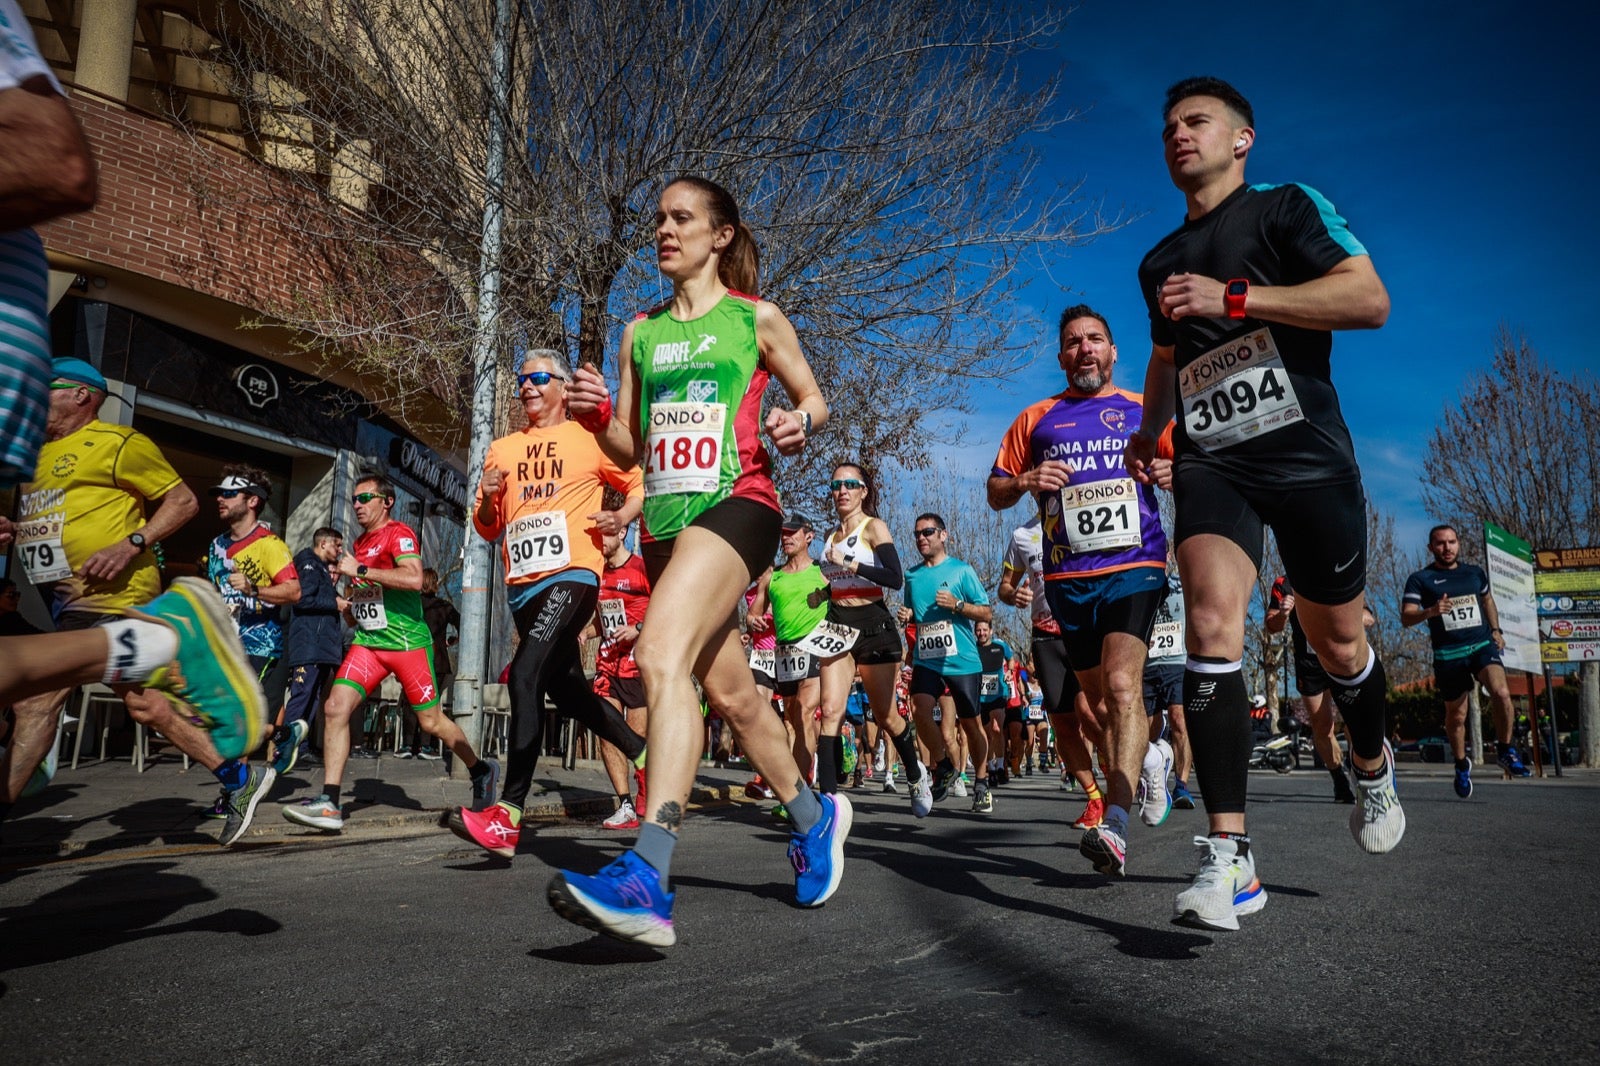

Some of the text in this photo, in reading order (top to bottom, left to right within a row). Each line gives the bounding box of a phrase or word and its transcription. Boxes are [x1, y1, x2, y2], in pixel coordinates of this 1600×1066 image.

[653, 341, 690, 366] ATARFE
[690, 360, 715, 369] Atarfe
[1193, 346, 1252, 383] FONDO
[1191, 367, 1286, 432] 3094
[654, 410, 704, 426] ONDO
[526, 441, 558, 459] WE
[1087, 435, 1128, 453] MÉD
[645, 436, 717, 474] 2180
[517, 458, 563, 482] RUN
[523, 482, 554, 501] MAD
[1078, 485, 1124, 501] FONDO
[515, 517, 552, 533] FONDO
[1077, 504, 1129, 536] 821
[511, 534, 564, 564] 3079
[354, 602, 378, 620] 266
[1448, 606, 1474, 622] 157
[810, 634, 845, 654] 438
[919, 634, 953, 650] 3080
[1157, 634, 1174, 649] 29
[781, 656, 805, 672] 116
